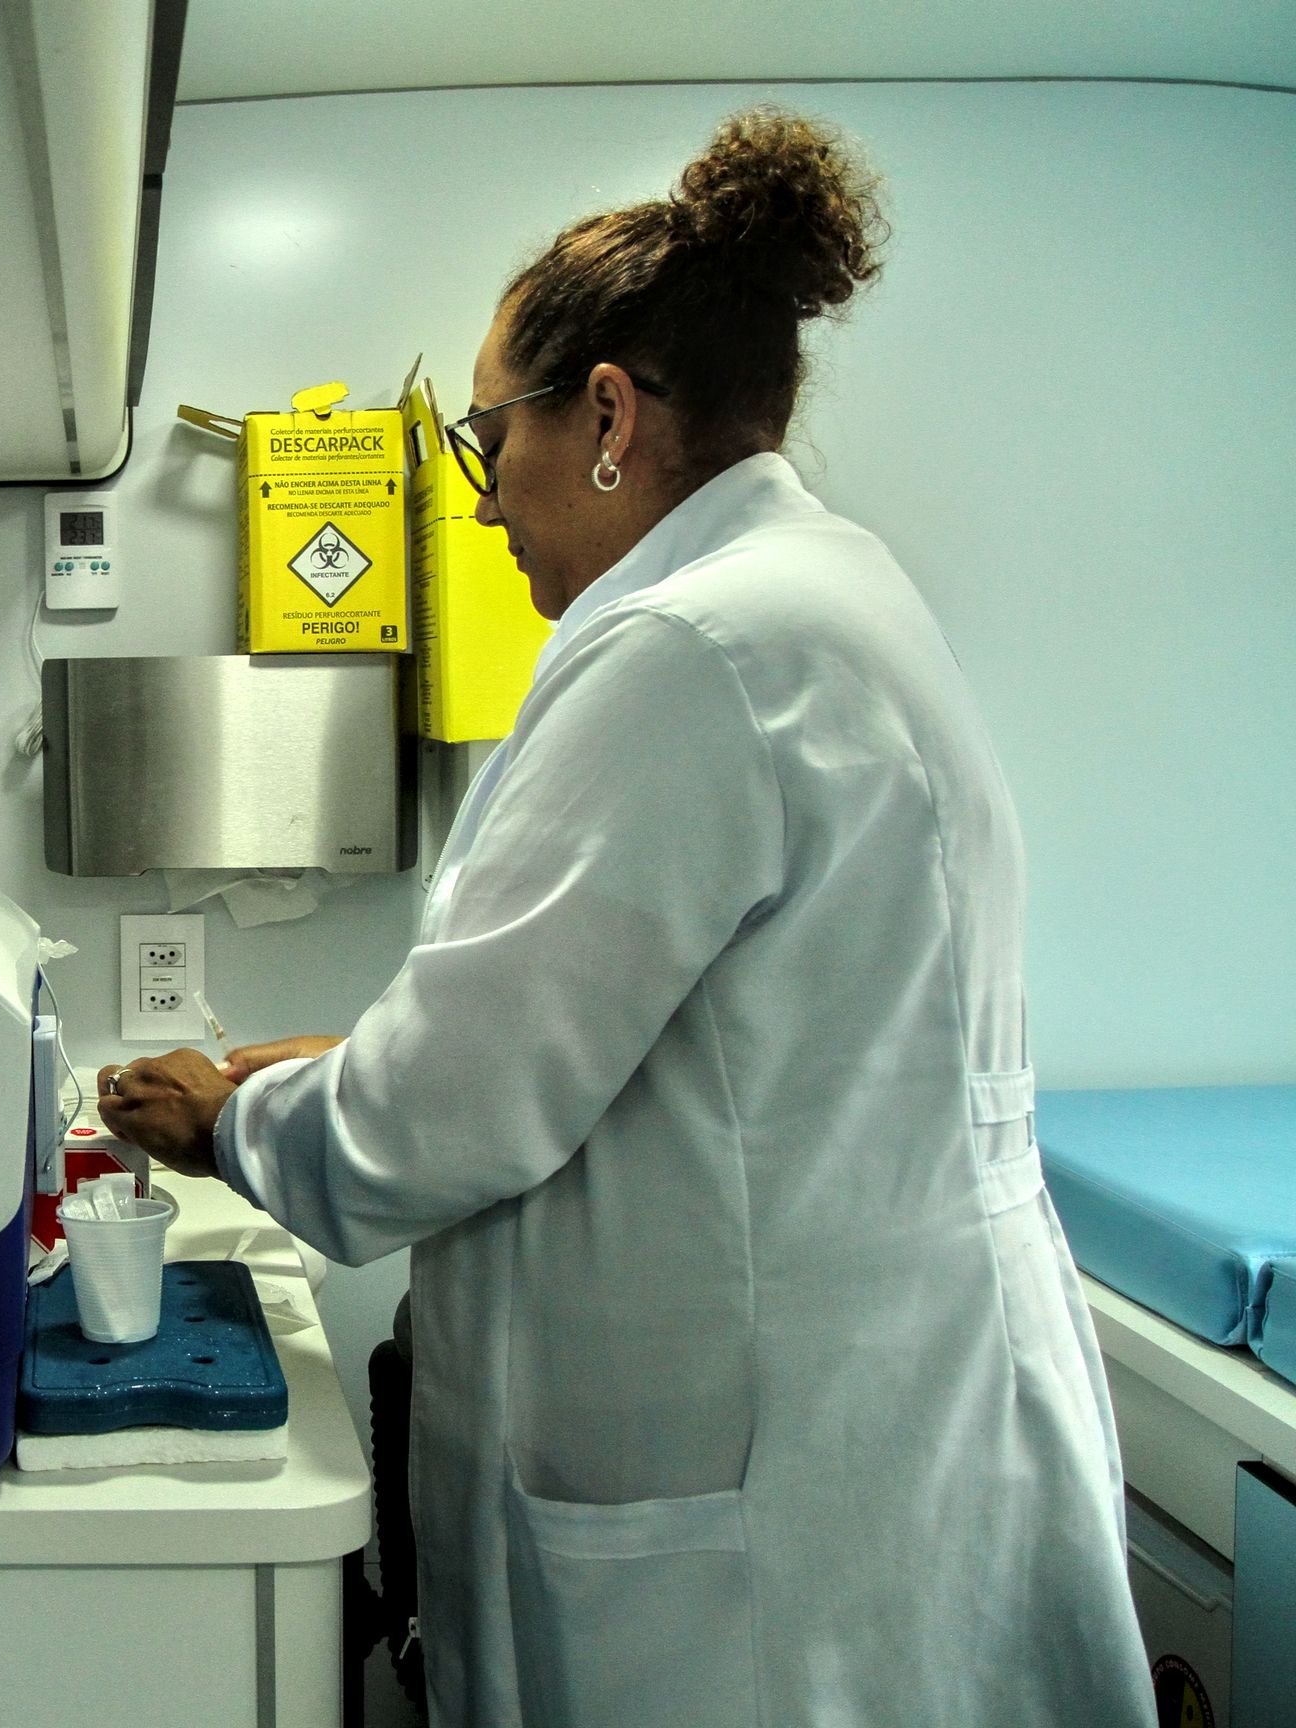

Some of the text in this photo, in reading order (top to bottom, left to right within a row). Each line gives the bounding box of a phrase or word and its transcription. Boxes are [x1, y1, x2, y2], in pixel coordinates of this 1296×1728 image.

[270, 428, 294, 436] Coletor
[333, 426, 384, 436] perfurocortantes
[270, 435, 385, 453] DESCARPACK
[270, 454, 293, 462] Colector
[274, 478, 382, 488] NÃO ENCHER ACIMA DESTA LINHA
[315, 488, 335, 496] ENCIMA
[355, 487, 369, 495] LÍNEA
[267, 500, 390, 511] RECOMENDA-SE DESCARTE ADEQUADO
[286, 510, 318, 518] RECOMENDA
[282, 610, 381, 619] RESÍDUO PERFUROCORTANTE
[302, 621, 360, 635] PERIGO!
[385, 626, 393, 637] 3
[315, 637, 346, 645] PELIGRO
[339, 845, 372, 855] nobre
